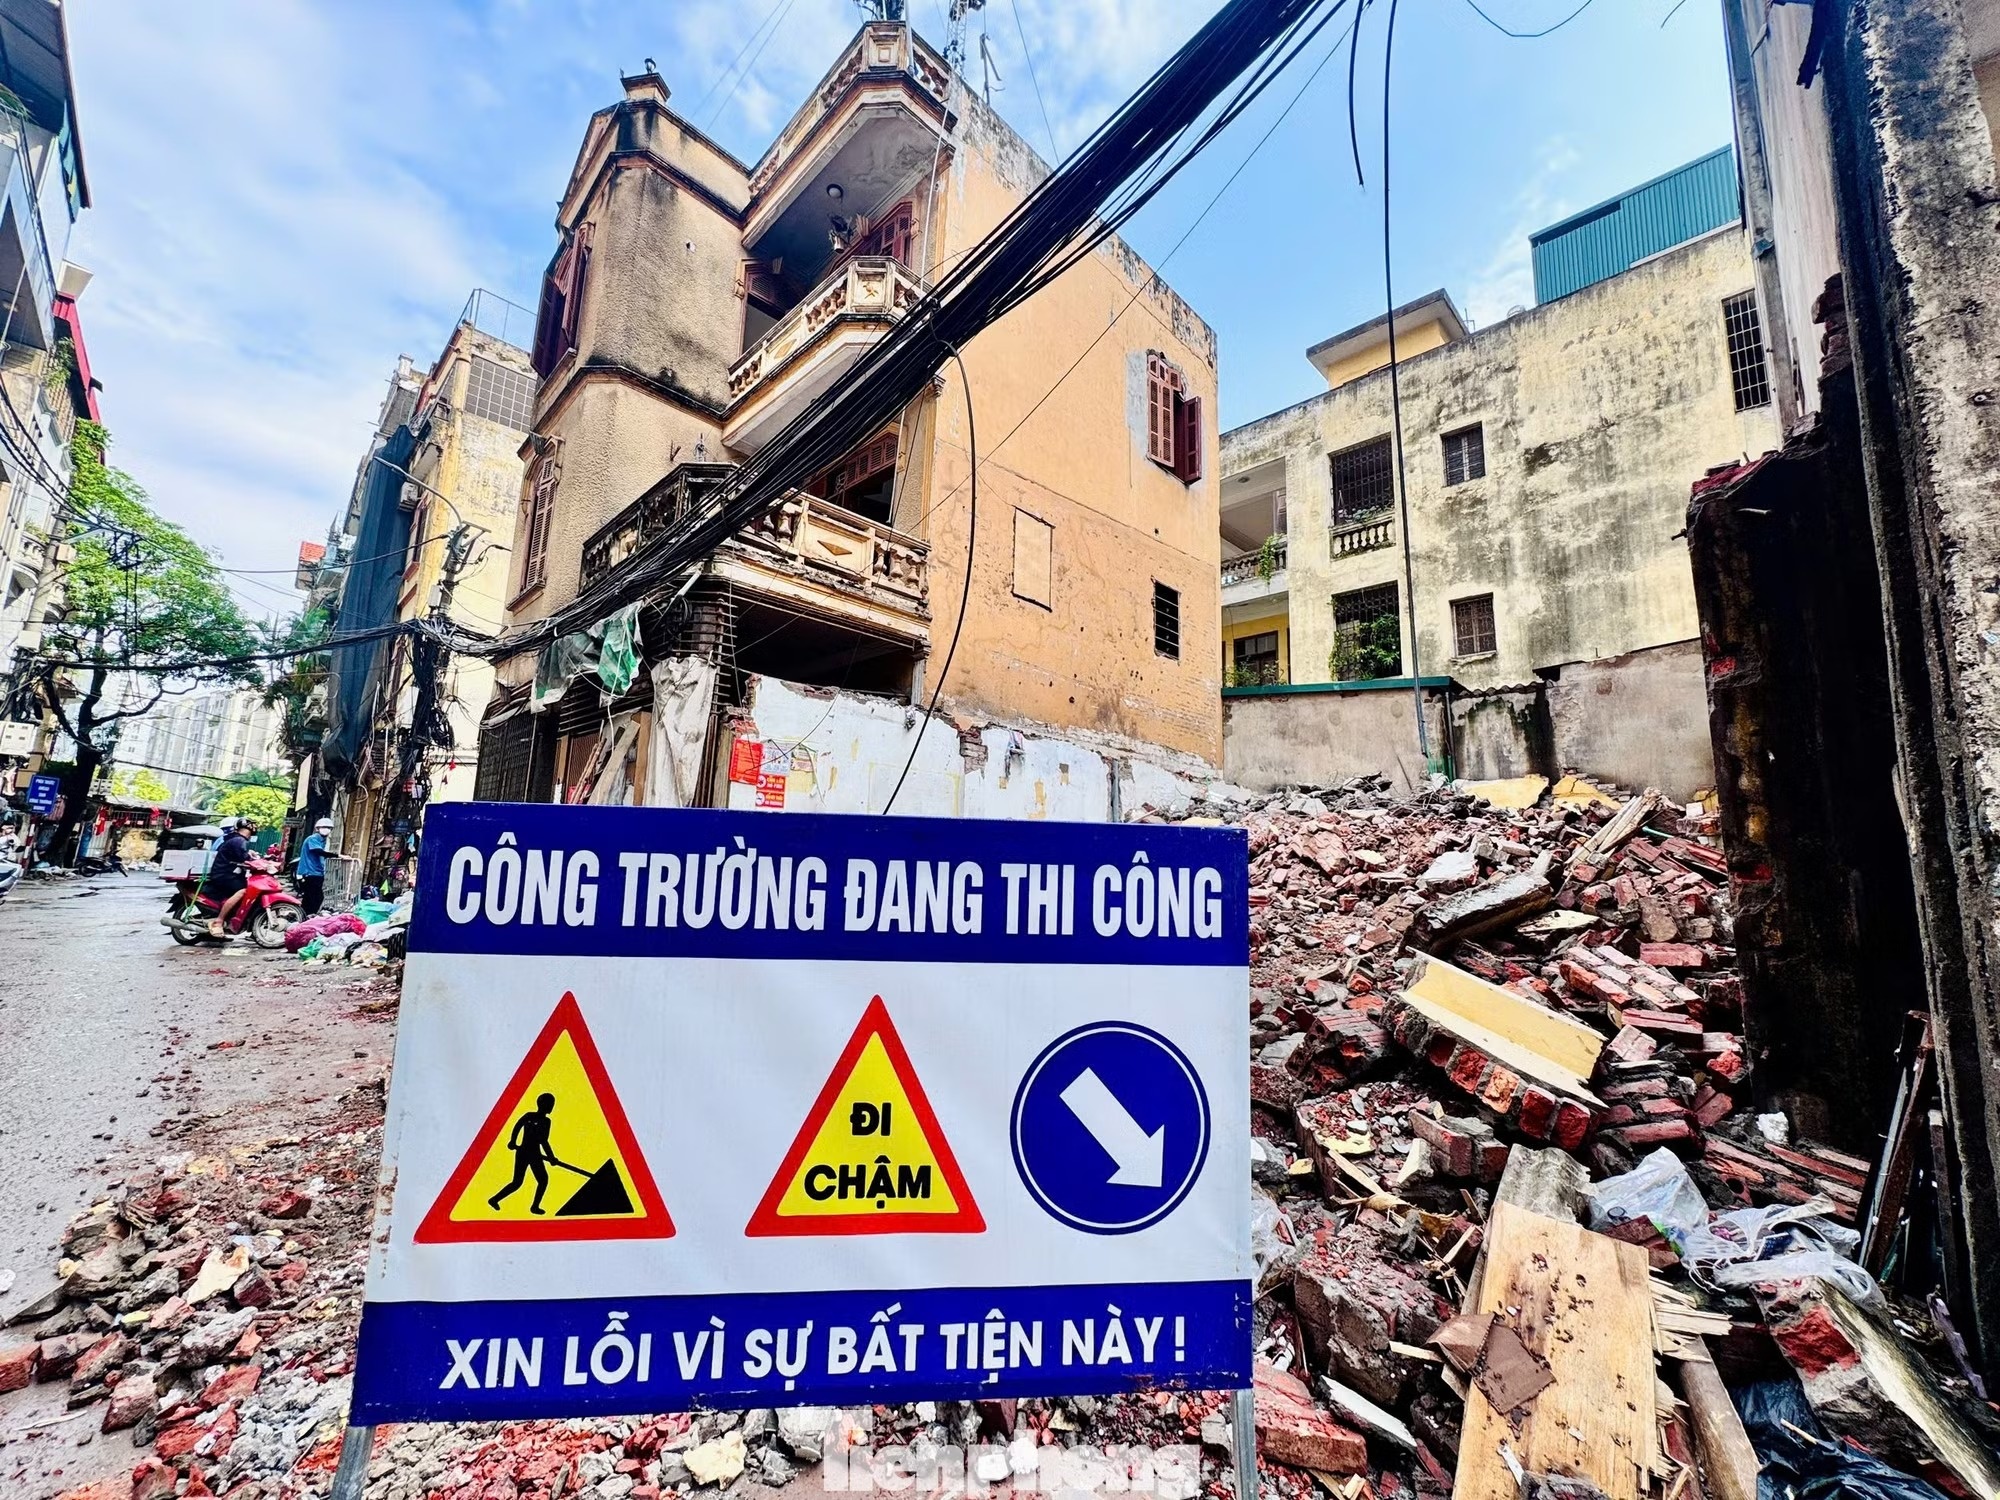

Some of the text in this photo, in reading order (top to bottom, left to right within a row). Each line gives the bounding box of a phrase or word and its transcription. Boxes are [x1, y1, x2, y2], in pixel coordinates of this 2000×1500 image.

[446, 831, 1223, 939] CÔNG TRƯỜNG ĐANG THI CÔNG
[849, 1102, 892, 1137] ĐI
[804, 1155, 932, 1209] CHẬM
[438, 1337, 544, 1389] XIN
[563, 1310, 652, 1386] LỖI
[672, 1315, 726, 1380] VÌ
[743, 1320, 813, 1391] SỰ
[827, 1302, 925, 1375] BẤT
[939, 1308, 1043, 1384] TIỆN
